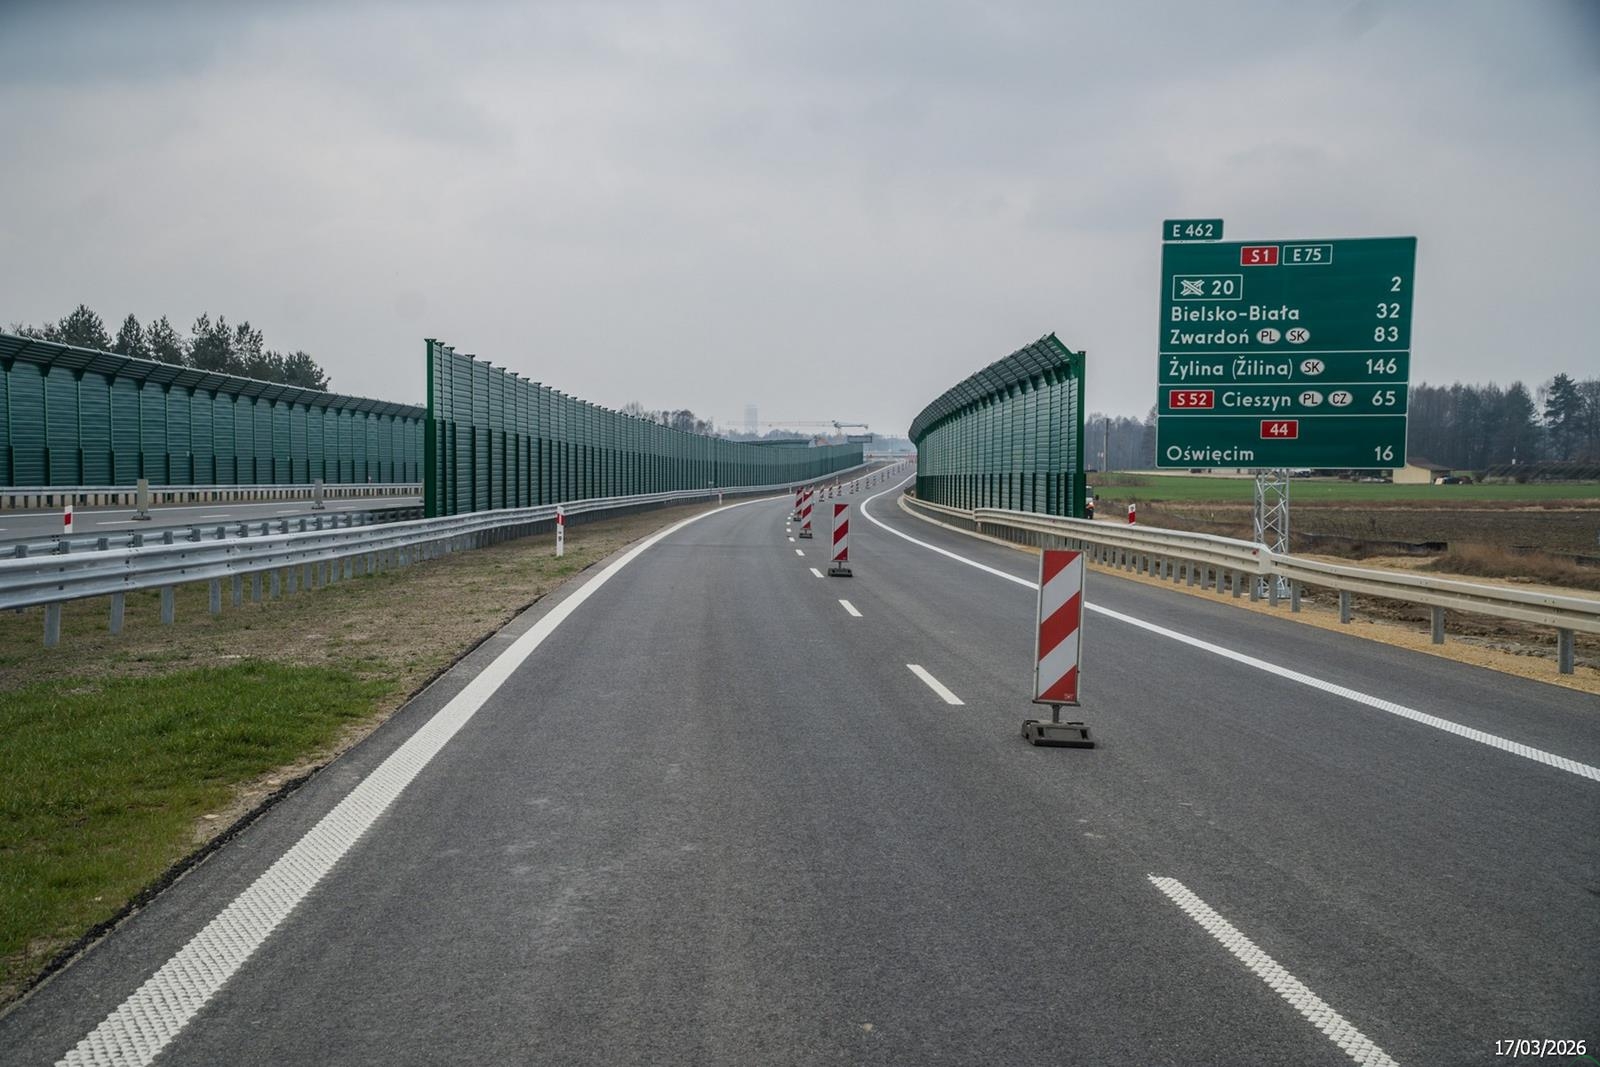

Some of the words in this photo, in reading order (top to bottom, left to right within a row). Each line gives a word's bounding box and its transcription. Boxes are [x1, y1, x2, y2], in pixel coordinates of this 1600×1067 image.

[1212, 280, 1234, 295] 20
[1391, 276, 1401, 291] 2
[1172, 305, 1299, 321] Bielsko-Biała
[1377, 303, 1400, 318] 32
[1170, 329, 1249, 344] Zwardoń
[1260, 331, 1277, 343] PL
[1290, 331, 1307, 342] SK
[1374, 326, 1398, 342] 83
[1169, 356, 1223, 380] Żylina
[1232, 355, 1293, 380] (Žilina)
[1303, 361, 1322, 373] SK
[1366, 358, 1397, 374] 146
[1222, 392, 1291, 410] Cieszyn
[1304, 394, 1320, 405] PL
[1331, 392, 1349, 404] CZ
[1372, 390, 1395, 405] 65
[1270, 424, 1288, 435] 44
[1167, 446, 1253, 464] Oświęcim
[1375, 446, 1393, 461] 16
